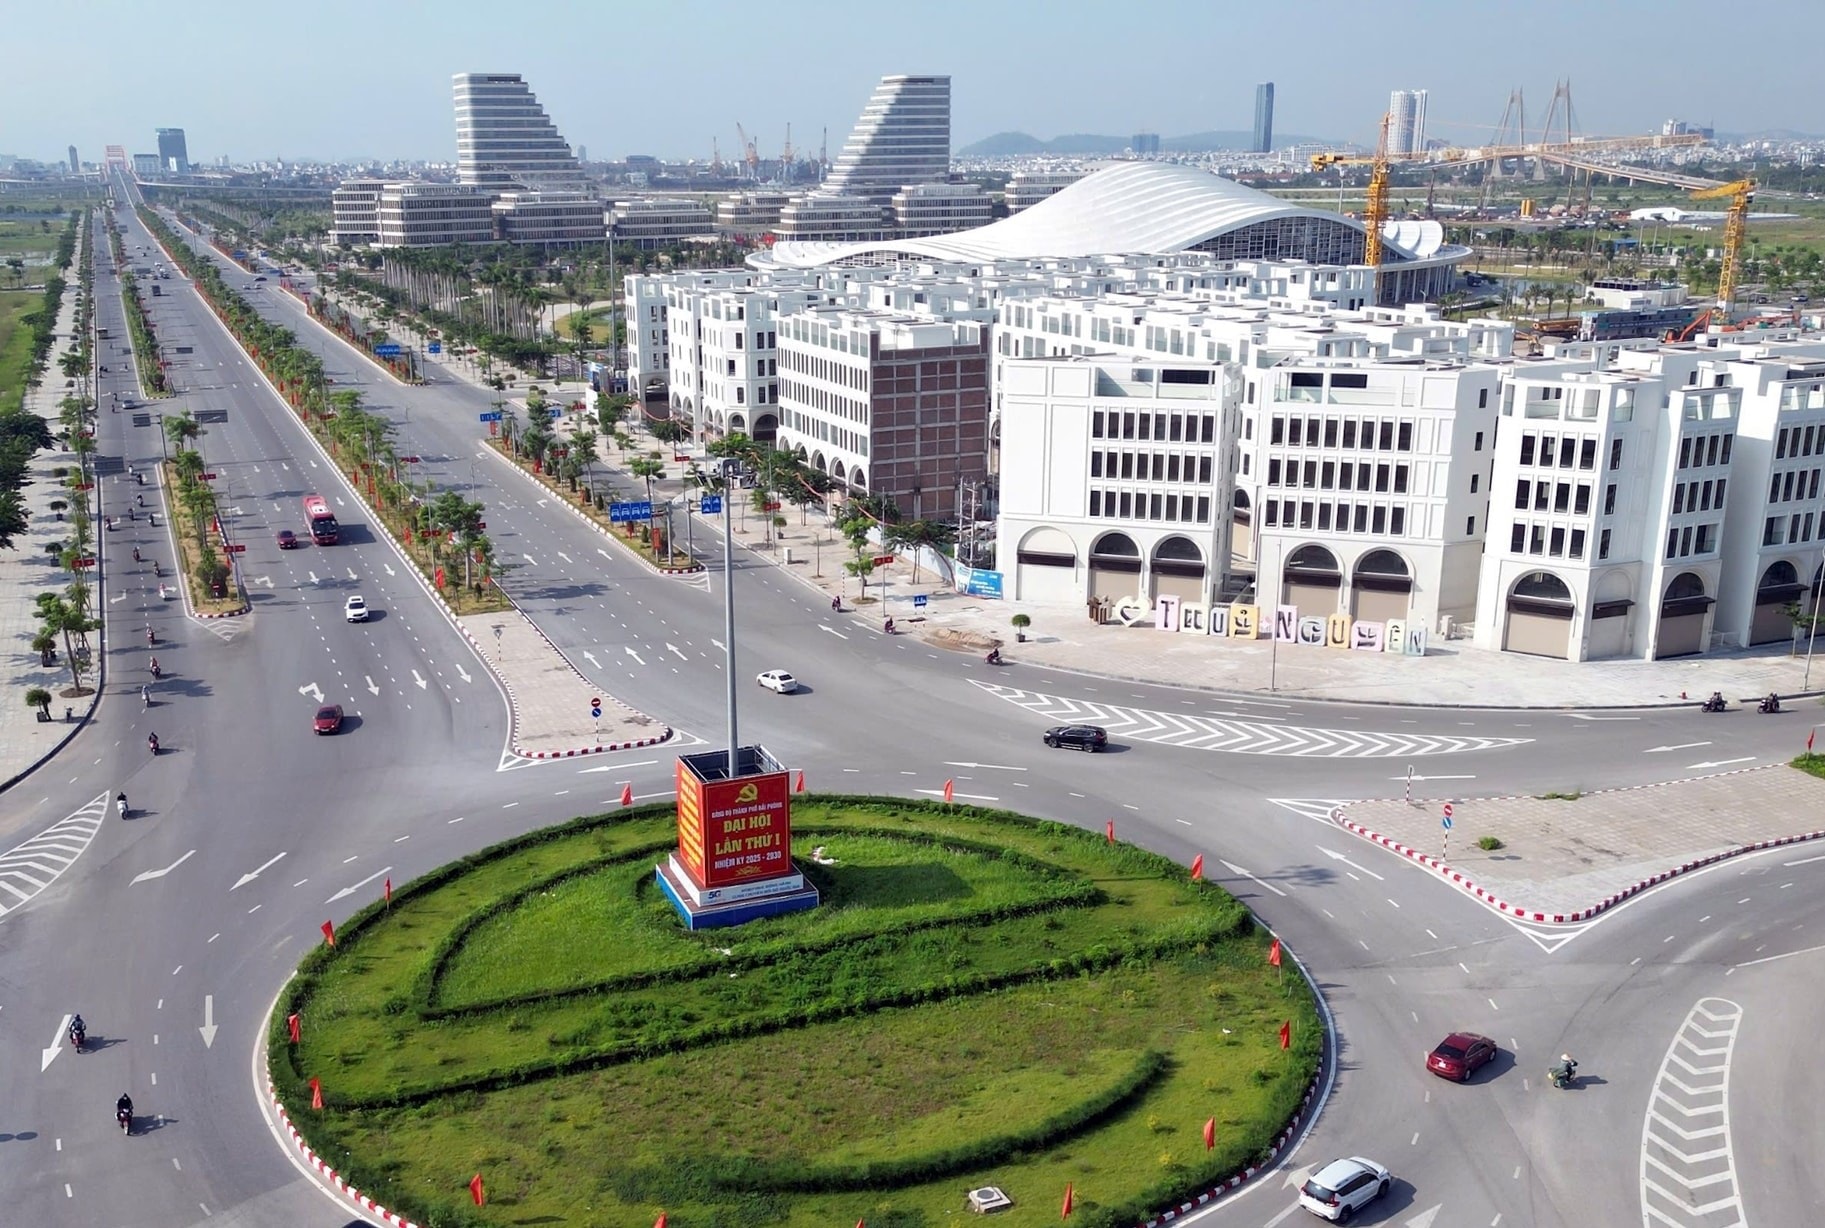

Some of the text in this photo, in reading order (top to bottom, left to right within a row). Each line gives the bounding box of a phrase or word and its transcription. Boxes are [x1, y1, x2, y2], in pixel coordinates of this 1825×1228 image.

[723, 813, 772, 833] ĐẠI HỘI
[715, 832, 780, 855] LẦN THỨ I
[746, 854, 761, 863] 2025
[708, 890, 721, 899] 5G
